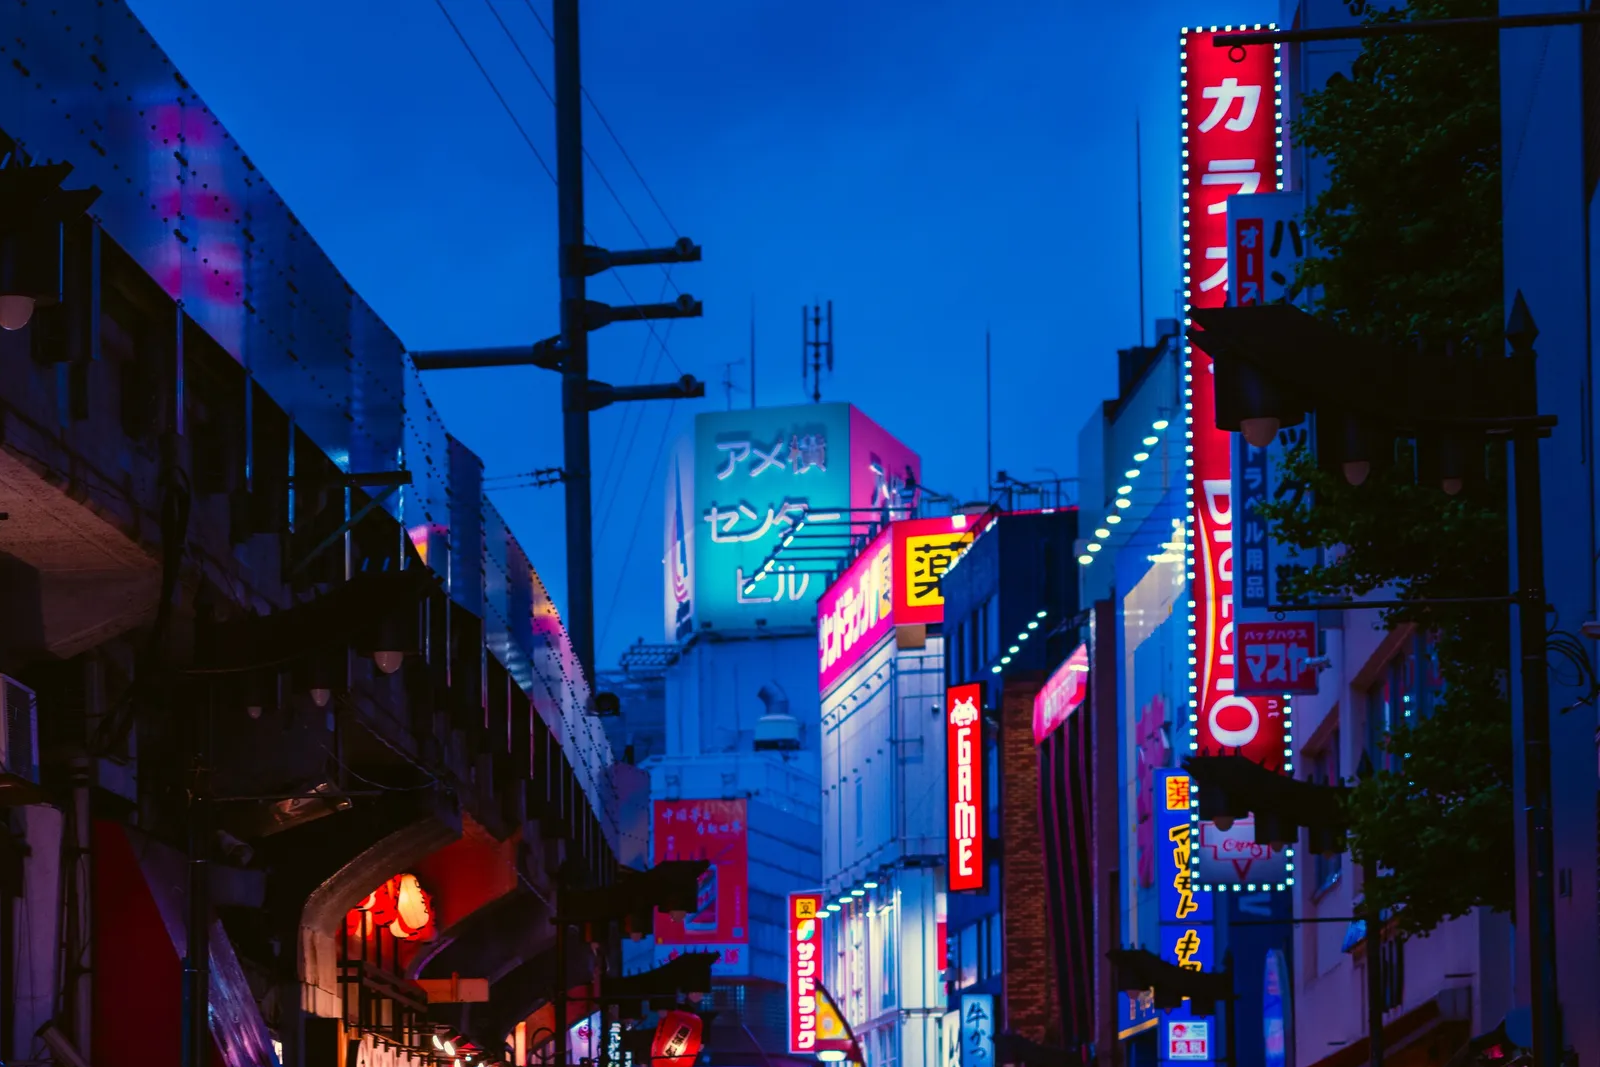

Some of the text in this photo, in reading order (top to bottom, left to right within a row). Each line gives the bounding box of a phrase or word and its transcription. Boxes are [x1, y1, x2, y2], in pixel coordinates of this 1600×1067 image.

[716, 434, 827, 480] アメ横
[704, 501, 841, 543] センター
[736, 564, 810, 604] ビル
[954, 727, 977, 876] GAME
